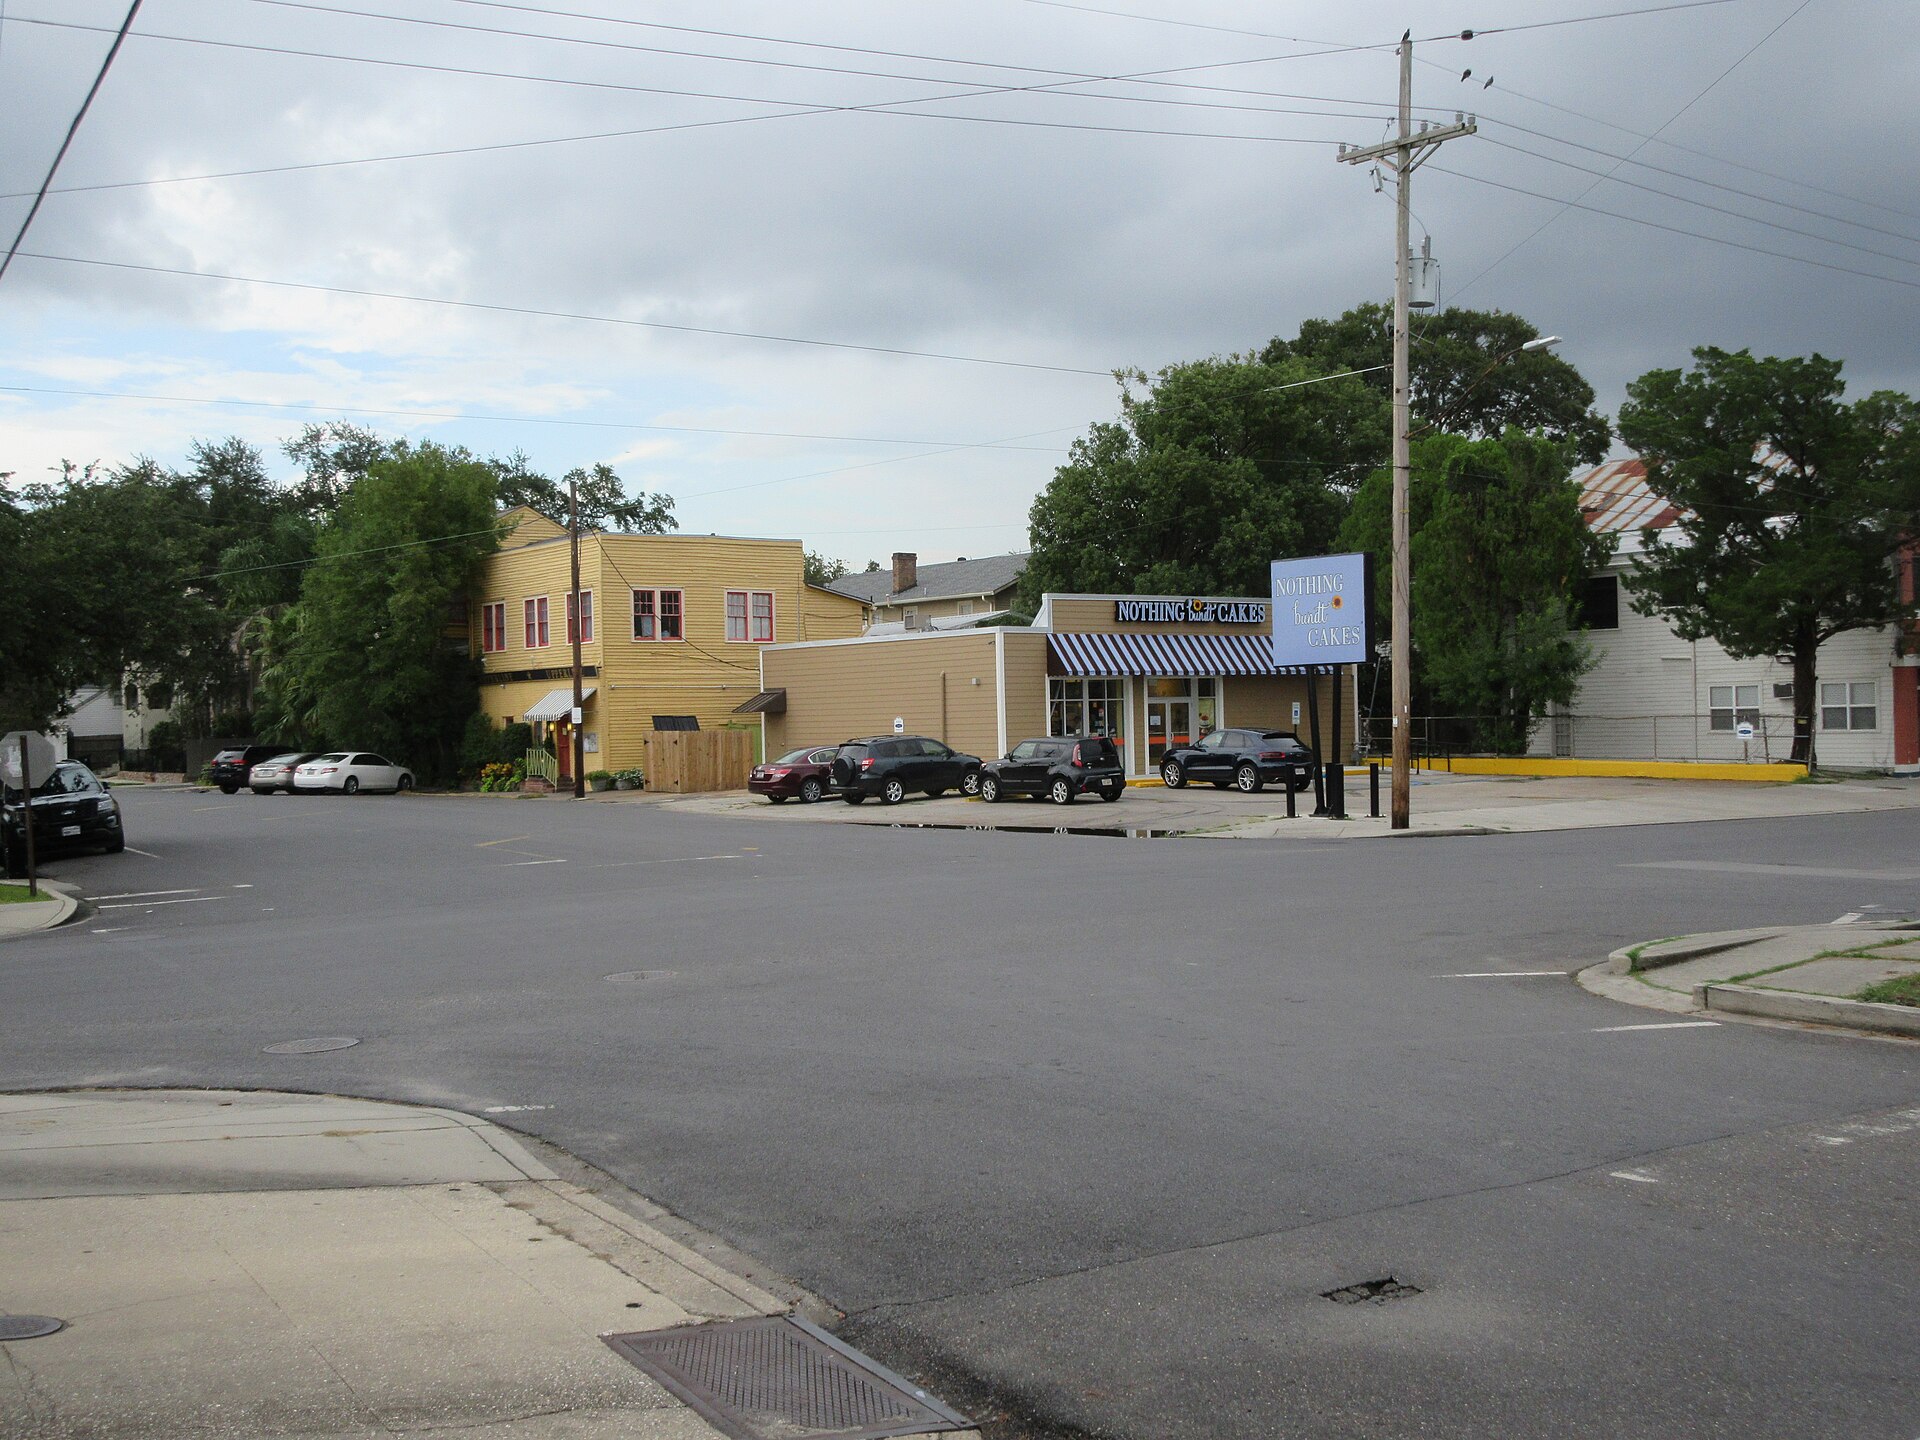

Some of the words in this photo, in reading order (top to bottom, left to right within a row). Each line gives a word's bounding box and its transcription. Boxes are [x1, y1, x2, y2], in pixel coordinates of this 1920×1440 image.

[1275, 573, 1344, 597] NOTHING
[1118, 601, 1186, 622] NOTHING
[1186, 598, 1217, 622] bundt
[1217, 603, 1266, 623] CAKES
[1293, 599, 1331, 625] bundt
[1308, 626, 1361, 647] CAKES
